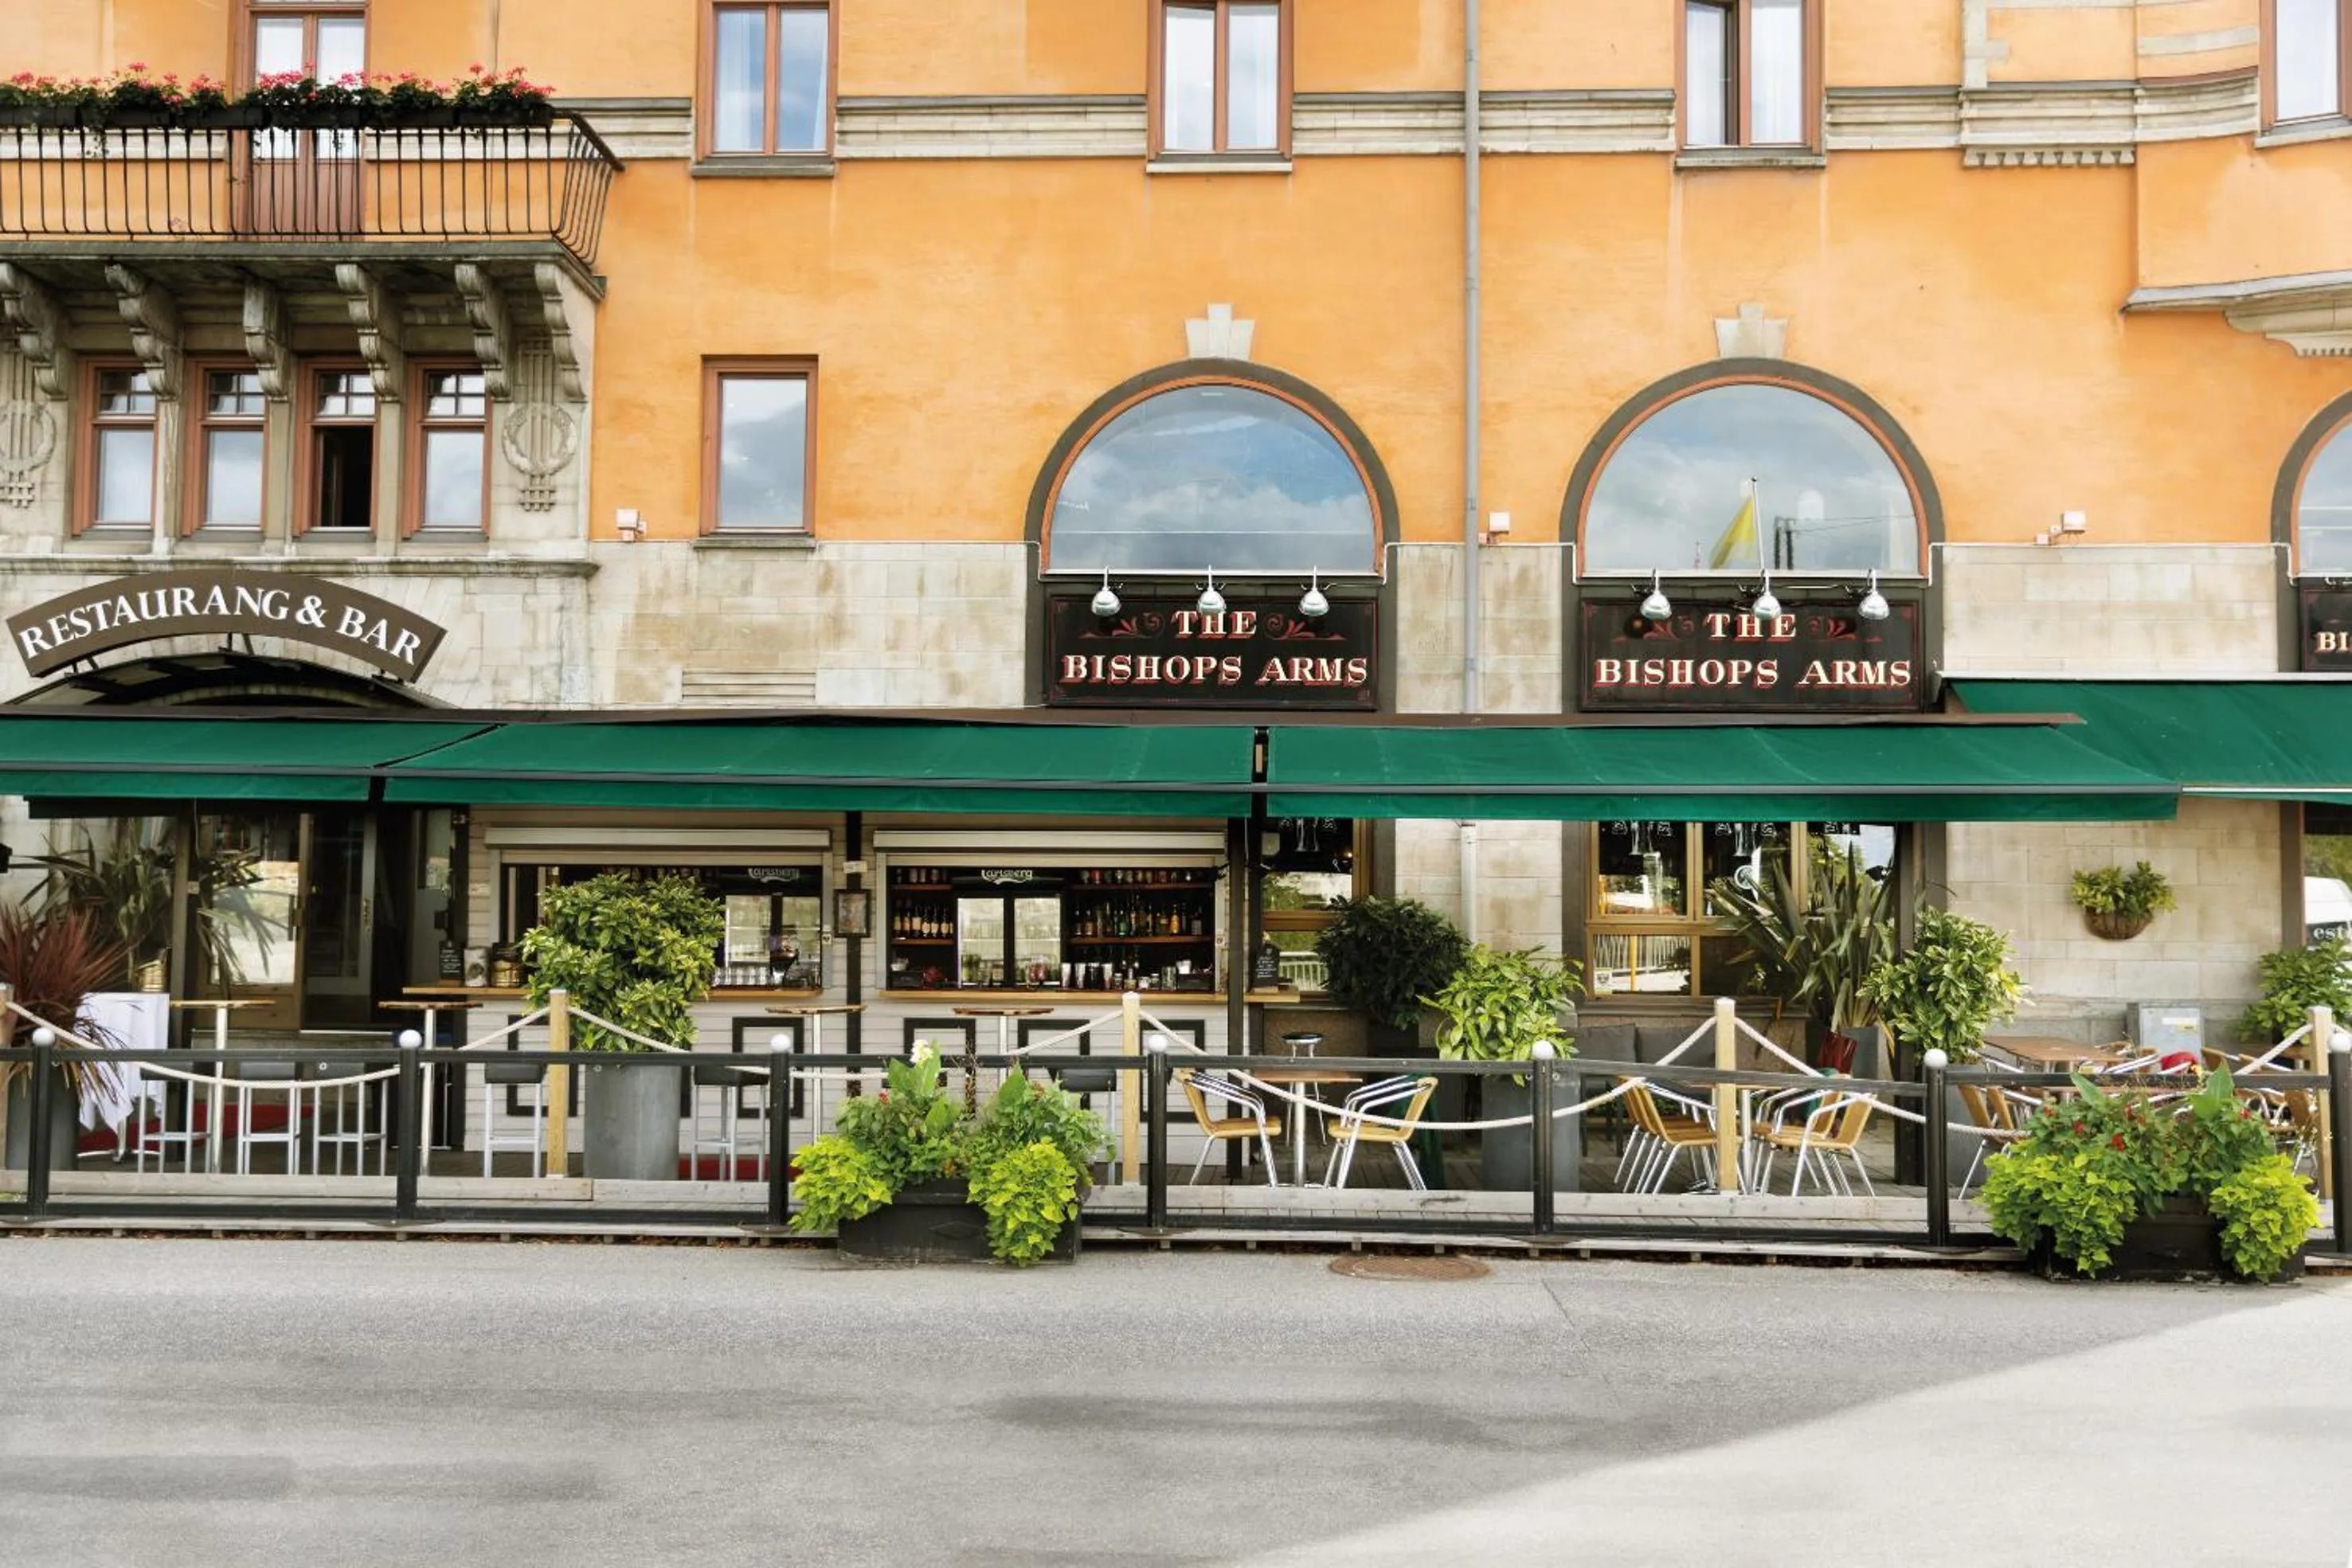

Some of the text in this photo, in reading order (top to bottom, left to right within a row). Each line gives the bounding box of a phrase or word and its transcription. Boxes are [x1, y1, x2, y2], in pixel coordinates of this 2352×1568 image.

[18, 585, 423, 665] RESTAURANG & BAR
[1173, 611, 1257, 637] THE
[1707, 613, 1797, 640] THE
[2315, 632, 2352, 653] BI
[1062, 655, 1368, 686] BISHOPS ARMS
[1594, 659, 1912, 686] BISHOPS ARMS
